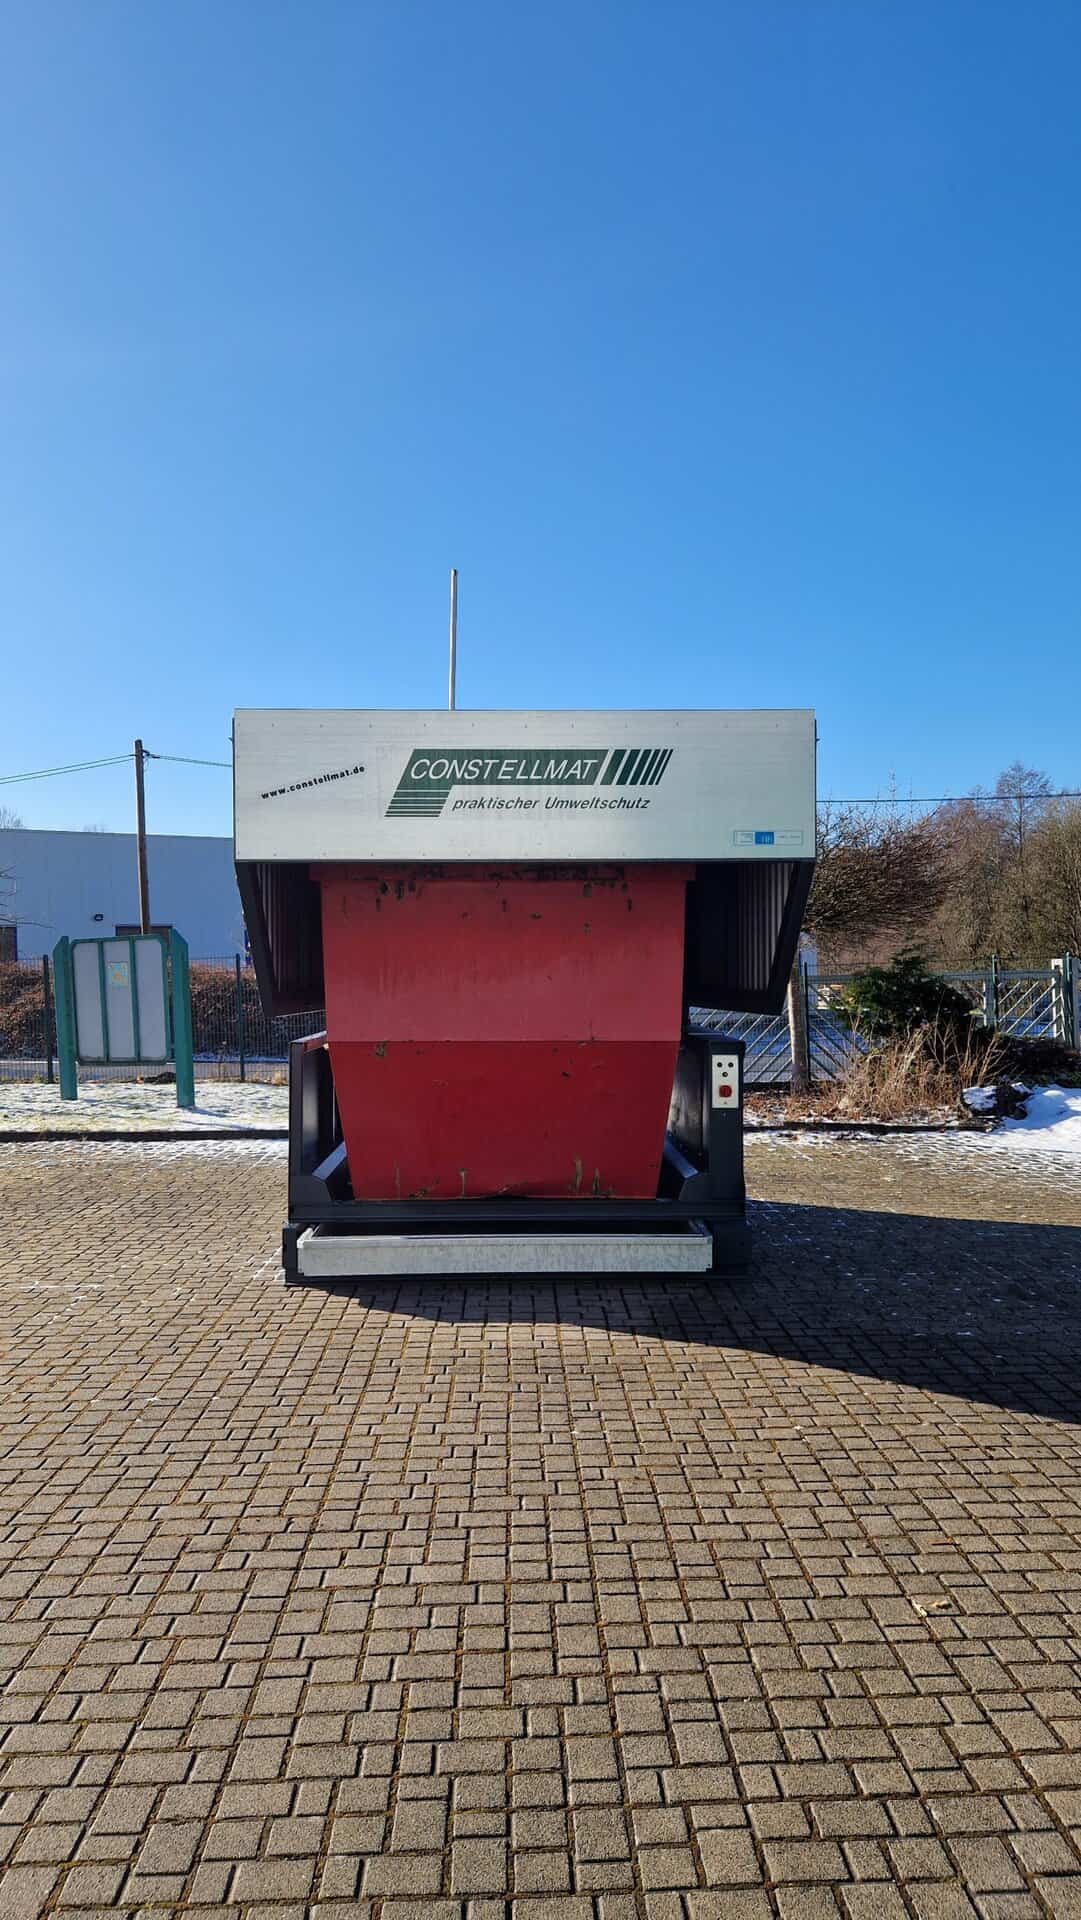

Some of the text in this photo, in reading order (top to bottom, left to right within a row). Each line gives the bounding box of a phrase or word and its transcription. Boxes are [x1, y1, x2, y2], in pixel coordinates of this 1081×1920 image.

[410, 758, 598, 780] CONSTELLMAT
[261, 766, 365, 799] www.constellmat.de
[452, 797, 651, 811] praktischer Umweltschutz
